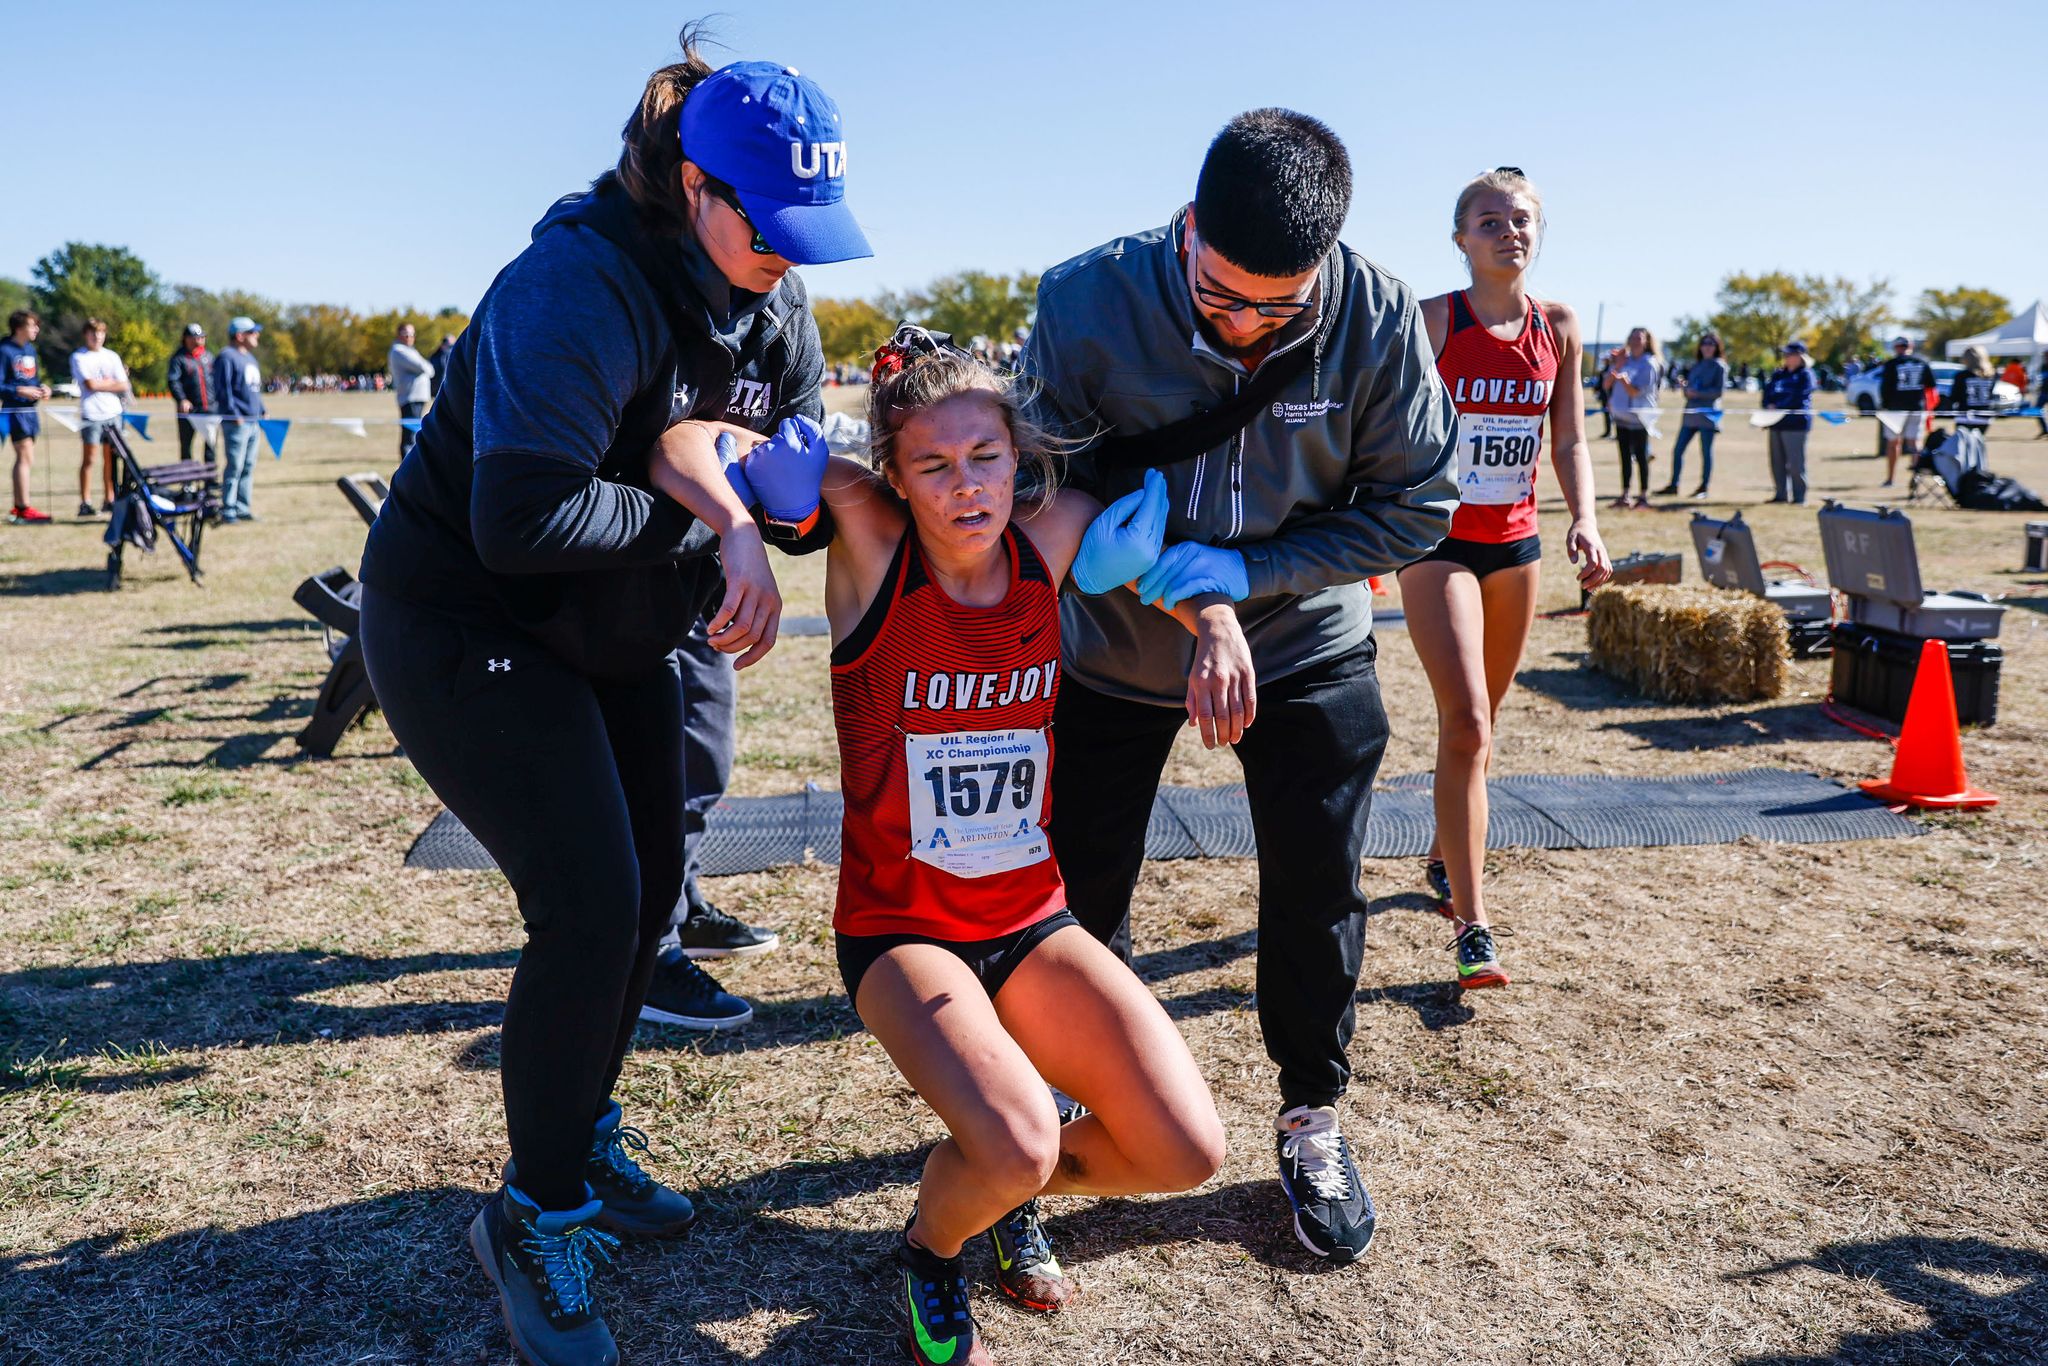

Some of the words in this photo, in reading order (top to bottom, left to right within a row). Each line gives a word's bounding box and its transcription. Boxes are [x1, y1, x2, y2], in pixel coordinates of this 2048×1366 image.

[791, 142, 848, 179] UTA
[1284, 403, 1308, 411] Texas
[1498, 417, 1522, 425] Region
[1469, 434, 1536, 467] 1580
[1843, 530, 1871, 554] RF
[903, 659, 1058, 710] LOVEJOY
[941, 736, 963, 745] UIL
[965, 734, 1004, 745] Region
[1007, 732, 1015, 741] II
[926, 749, 944, 760] XC
[947, 743, 1032, 759] Championship
[924, 758, 1036, 817] 1579
[960, 831, 1009, 843] ARLINGTON
[964, 825, 992, 834] University
